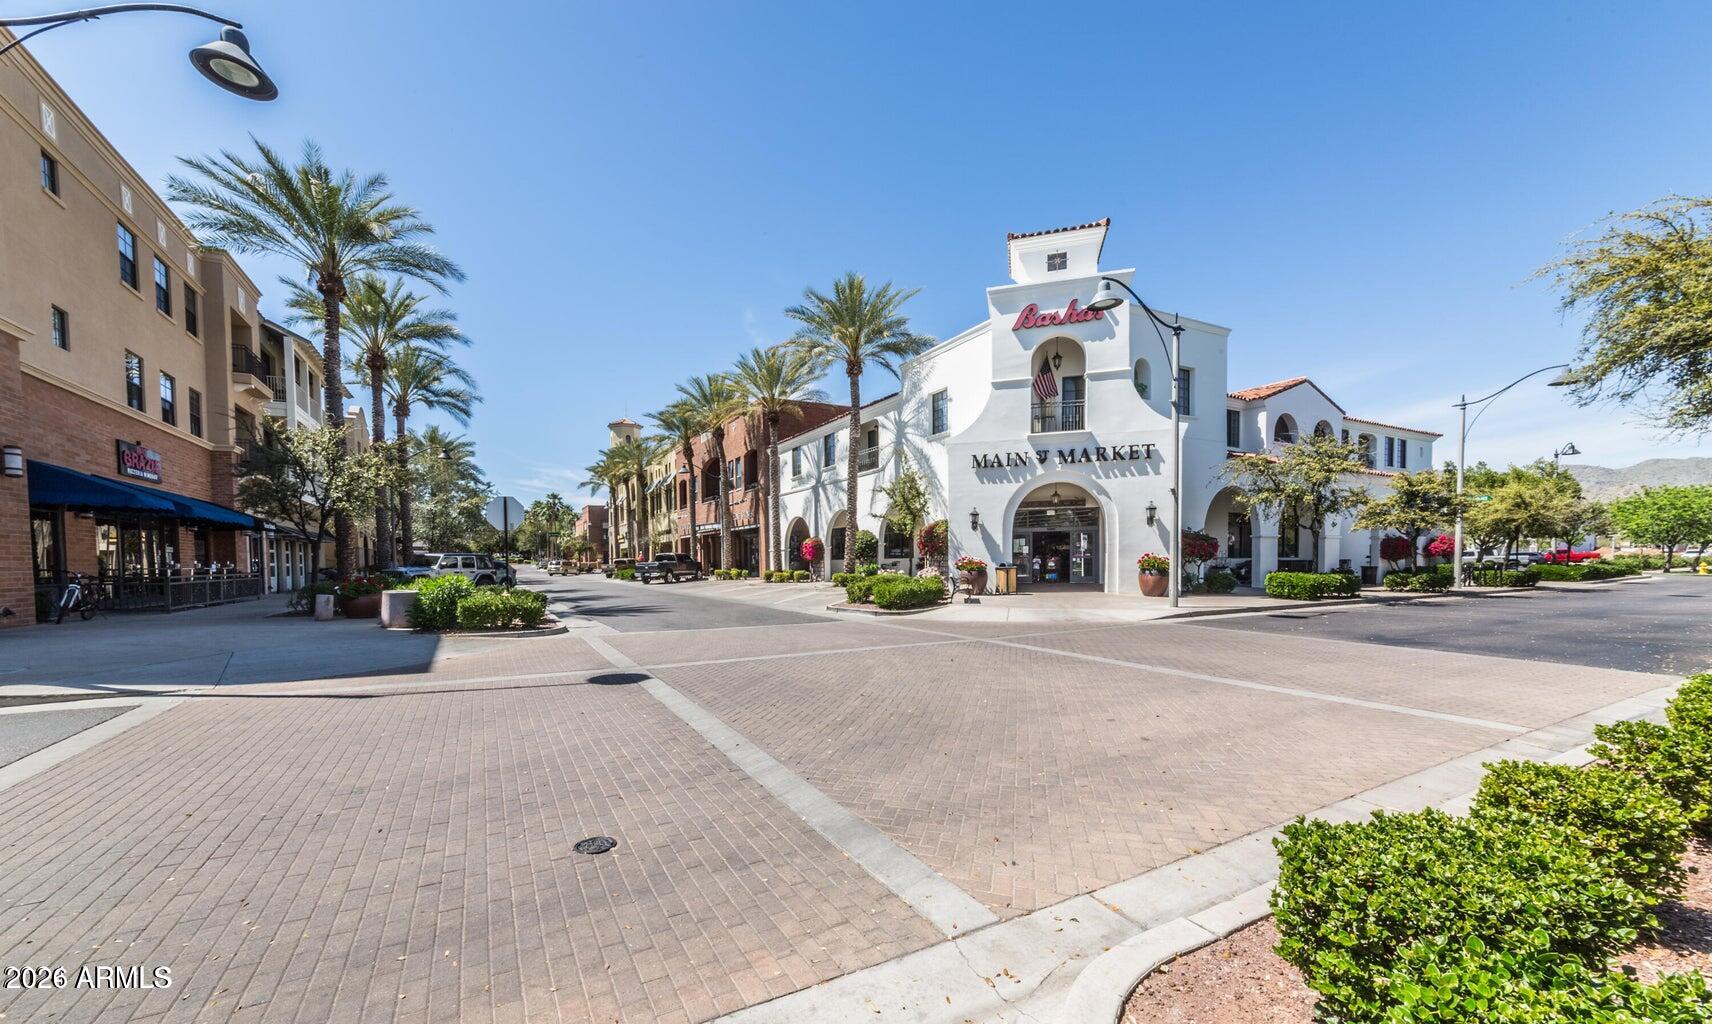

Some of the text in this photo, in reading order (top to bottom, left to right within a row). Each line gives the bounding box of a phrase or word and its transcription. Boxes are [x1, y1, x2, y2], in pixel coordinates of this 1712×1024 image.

[972, 443, 1156, 469] MAIN ST MARKET
